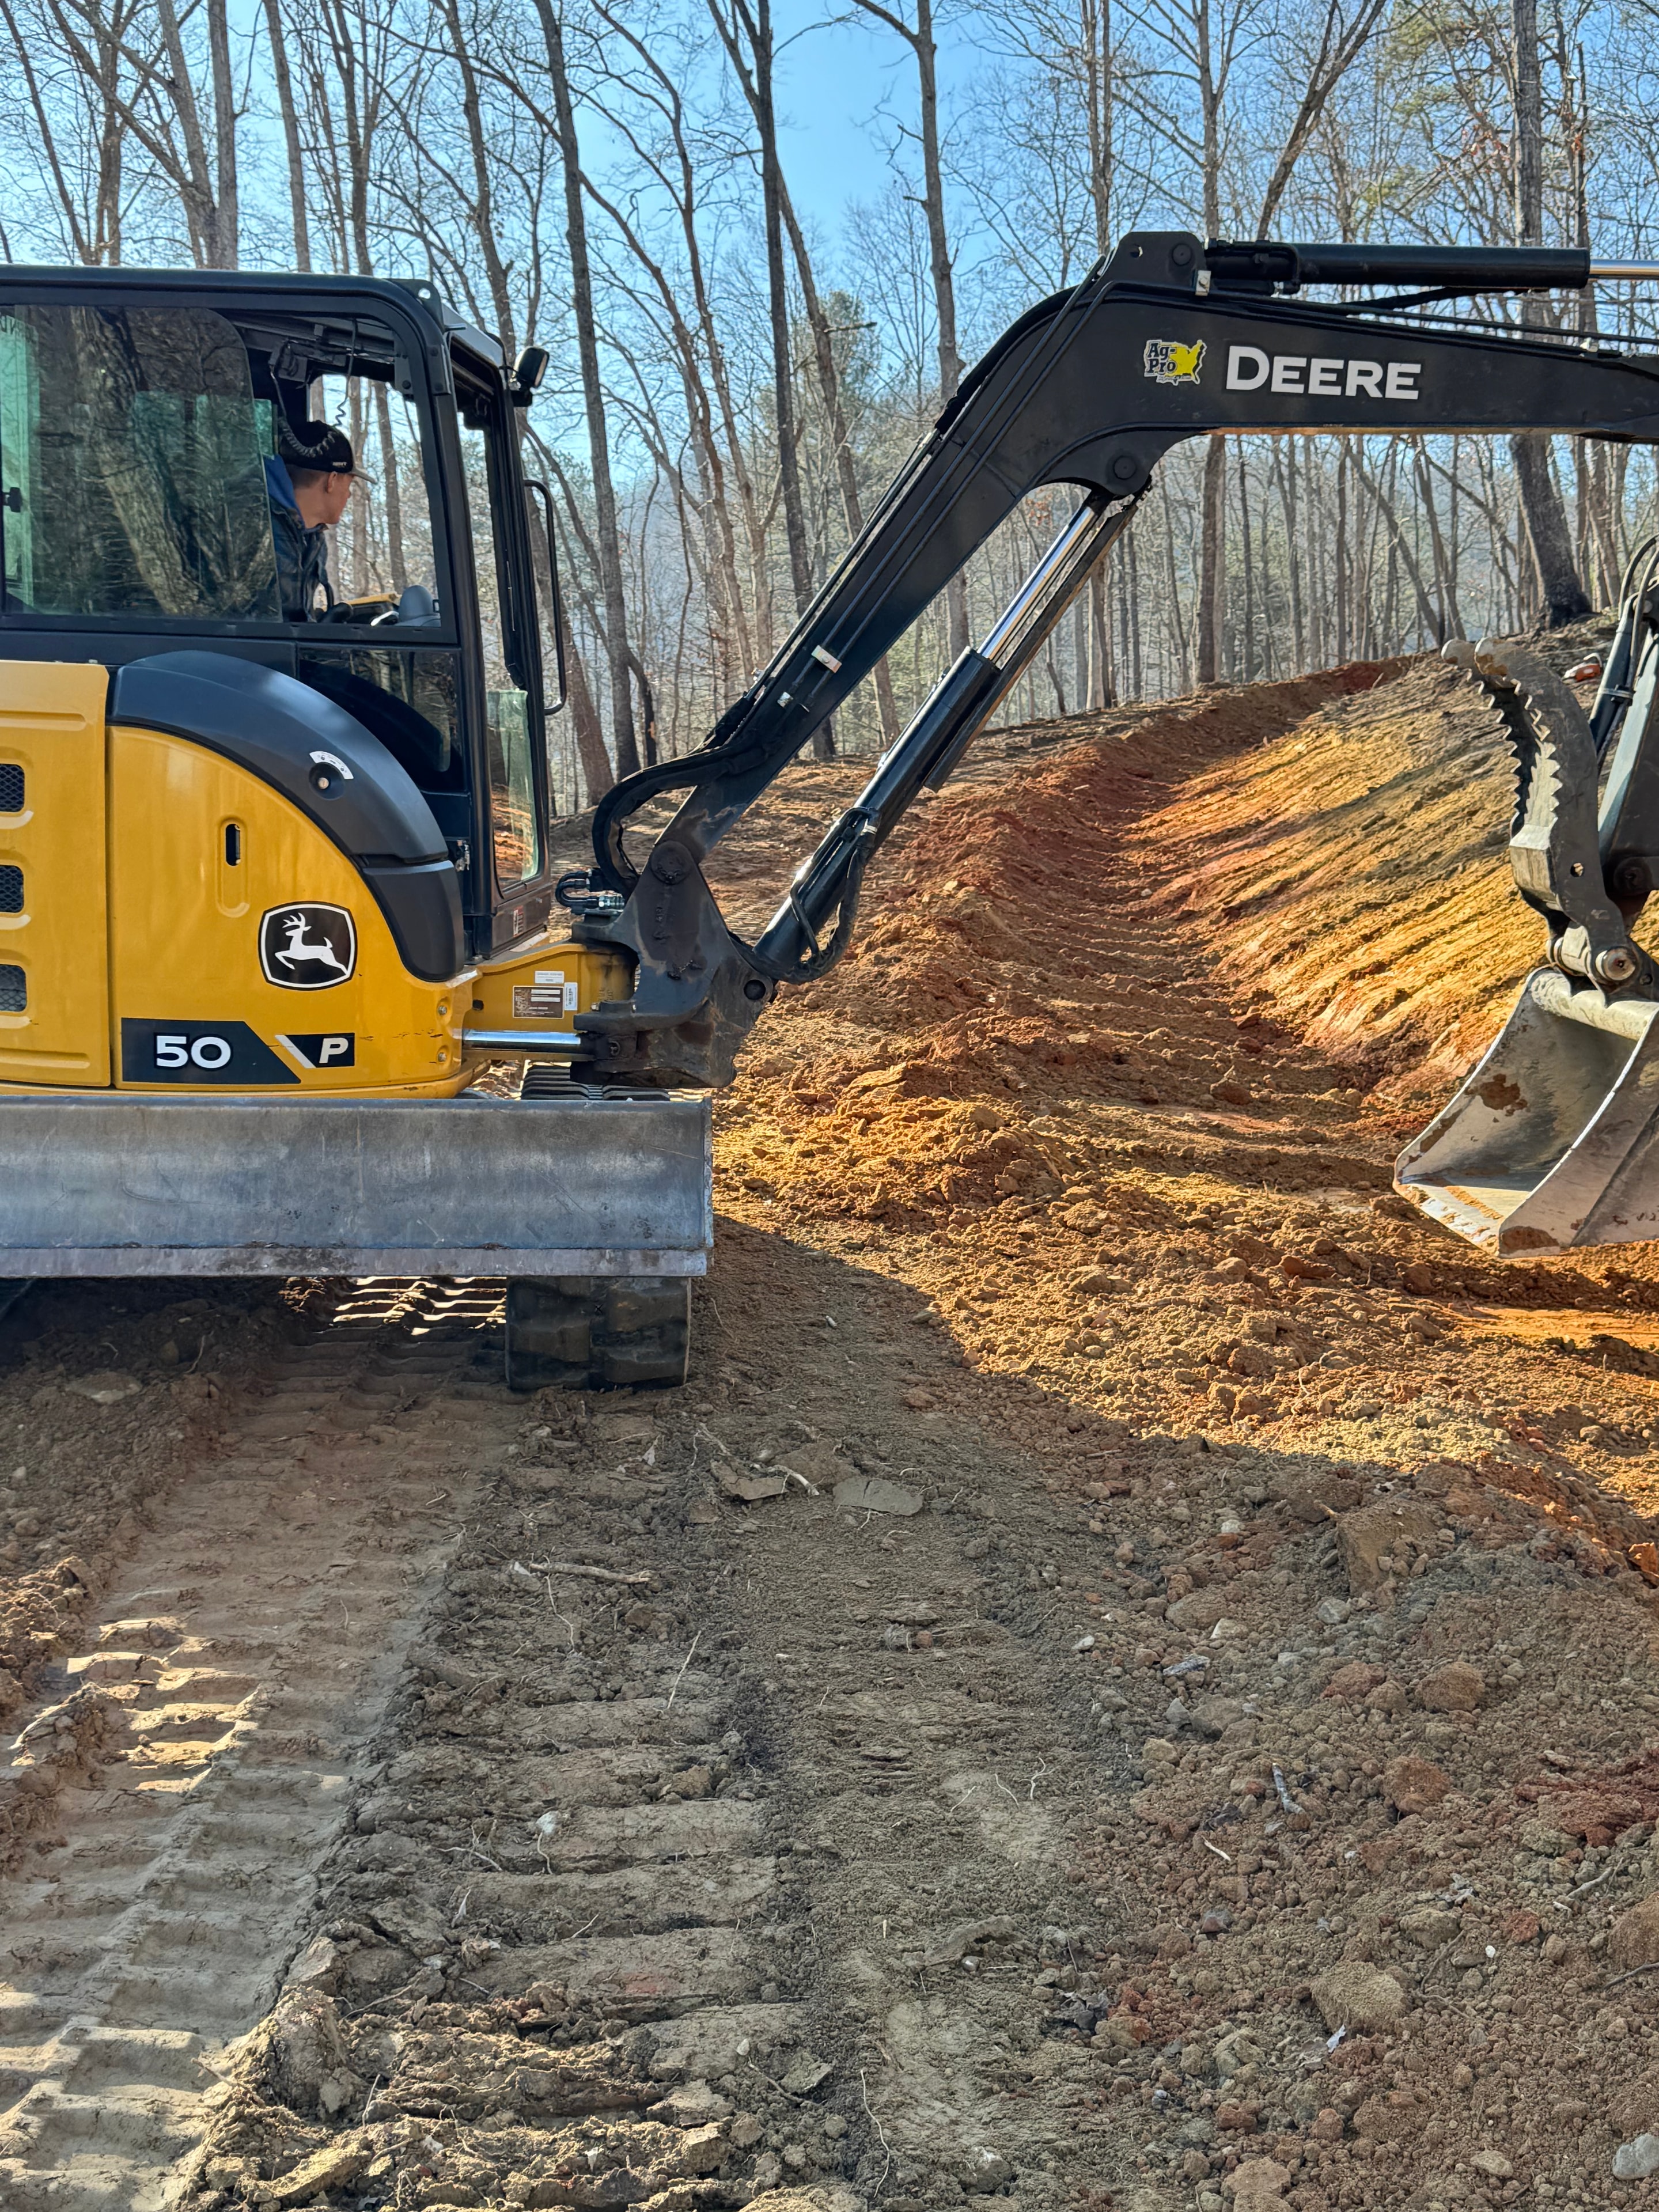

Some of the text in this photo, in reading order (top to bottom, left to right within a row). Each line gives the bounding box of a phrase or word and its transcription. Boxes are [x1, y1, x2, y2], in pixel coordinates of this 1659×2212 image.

[1147, 343, 1176, 360] Ag-
[1147, 358, 1176, 373] Pro
[1226, 345, 1421, 400] DEERE
[156, 1035, 349, 1069] 50 P
